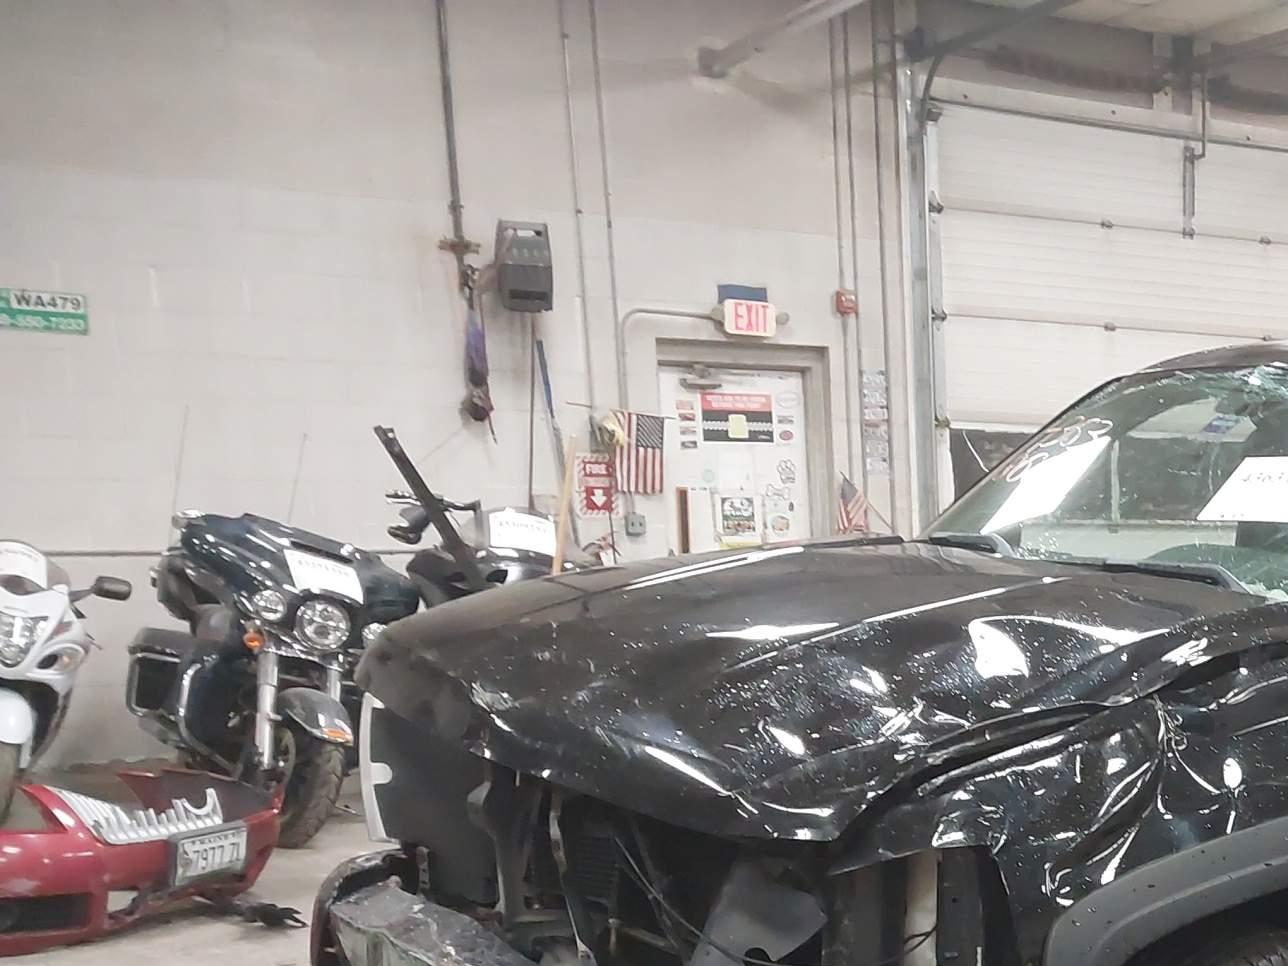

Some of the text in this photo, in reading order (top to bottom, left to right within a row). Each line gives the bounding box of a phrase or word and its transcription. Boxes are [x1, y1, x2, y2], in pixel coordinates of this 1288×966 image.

[13, 293, 81, 311] WA479
[734, 302, 769, 332] EXIT
[191, 844, 226, 872] 7977
